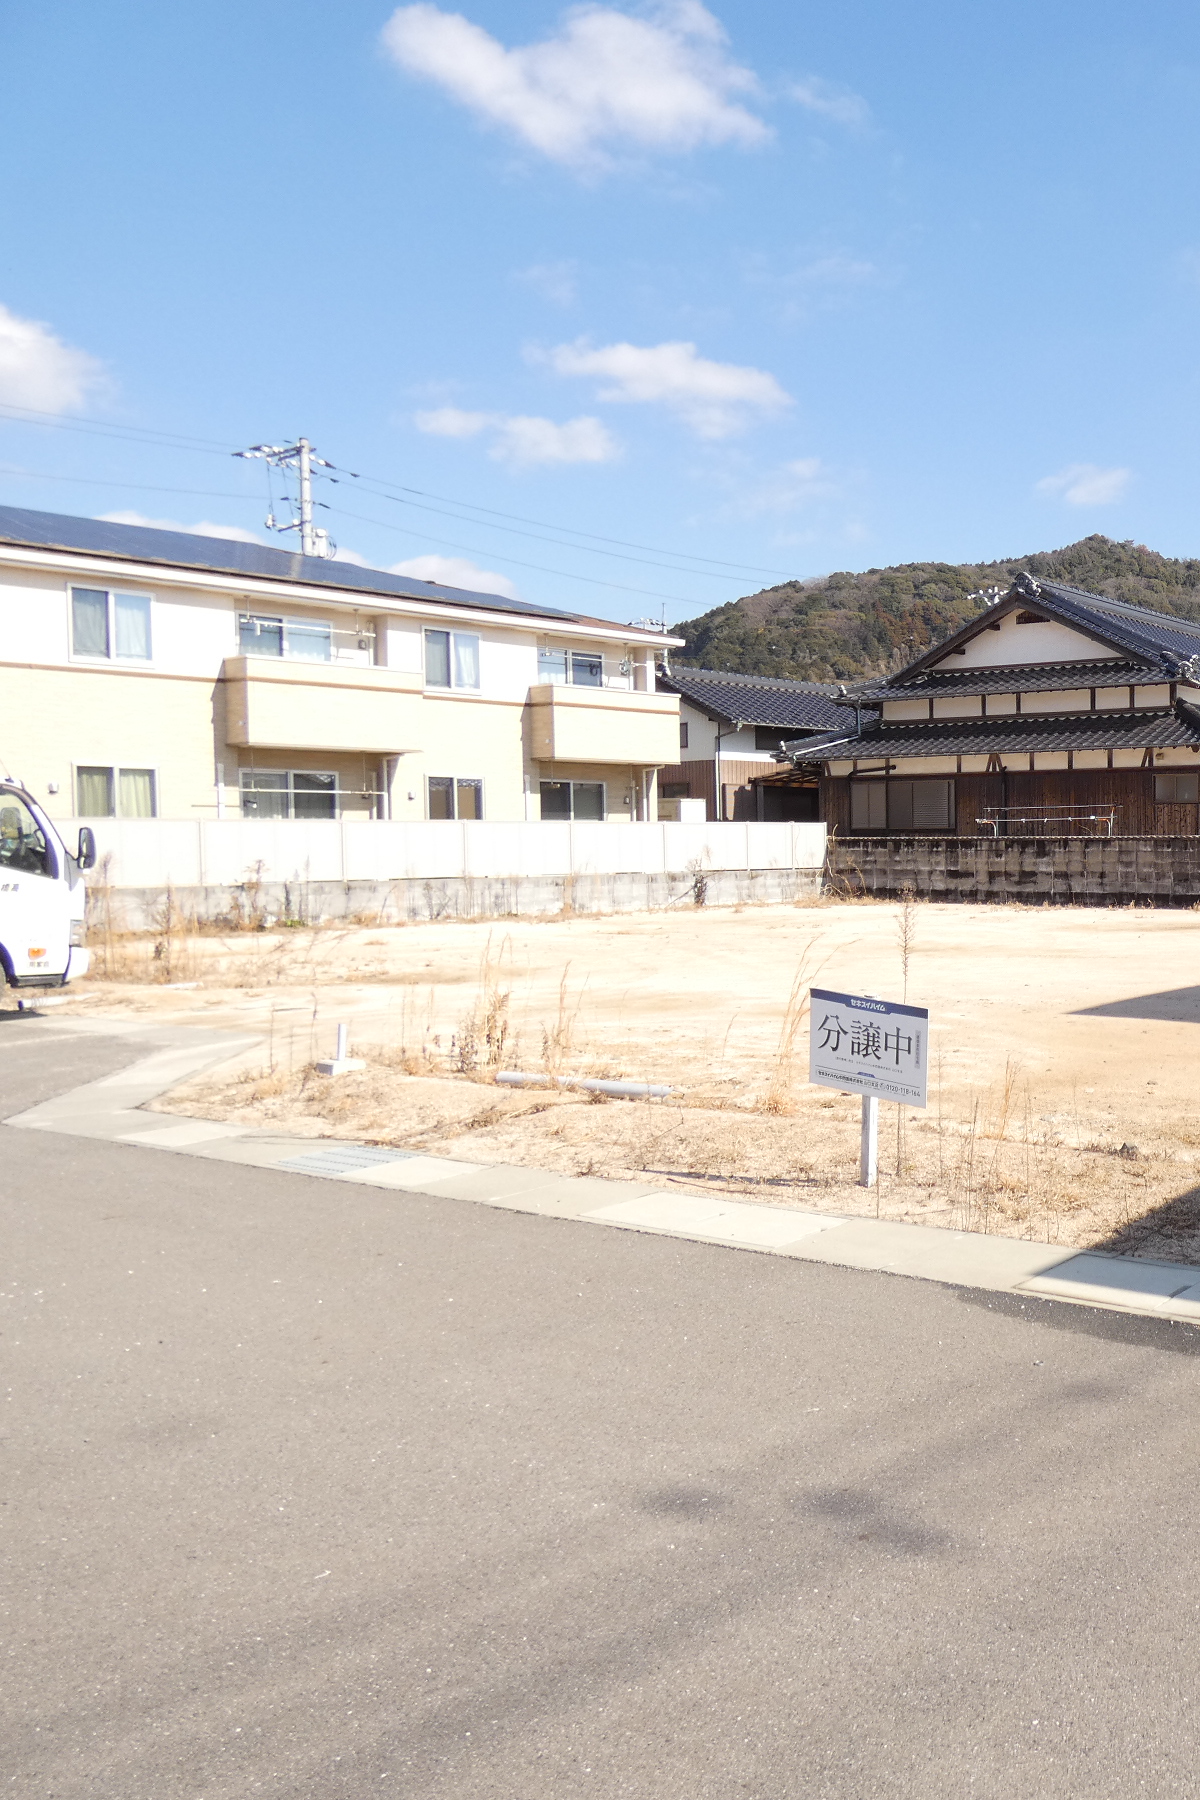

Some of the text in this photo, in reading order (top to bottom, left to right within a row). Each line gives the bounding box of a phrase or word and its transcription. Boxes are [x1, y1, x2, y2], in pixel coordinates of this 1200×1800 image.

[850, 999, 886, 1012] セキスイハイム
[817, 1014, 913, 1065] 分譲中
